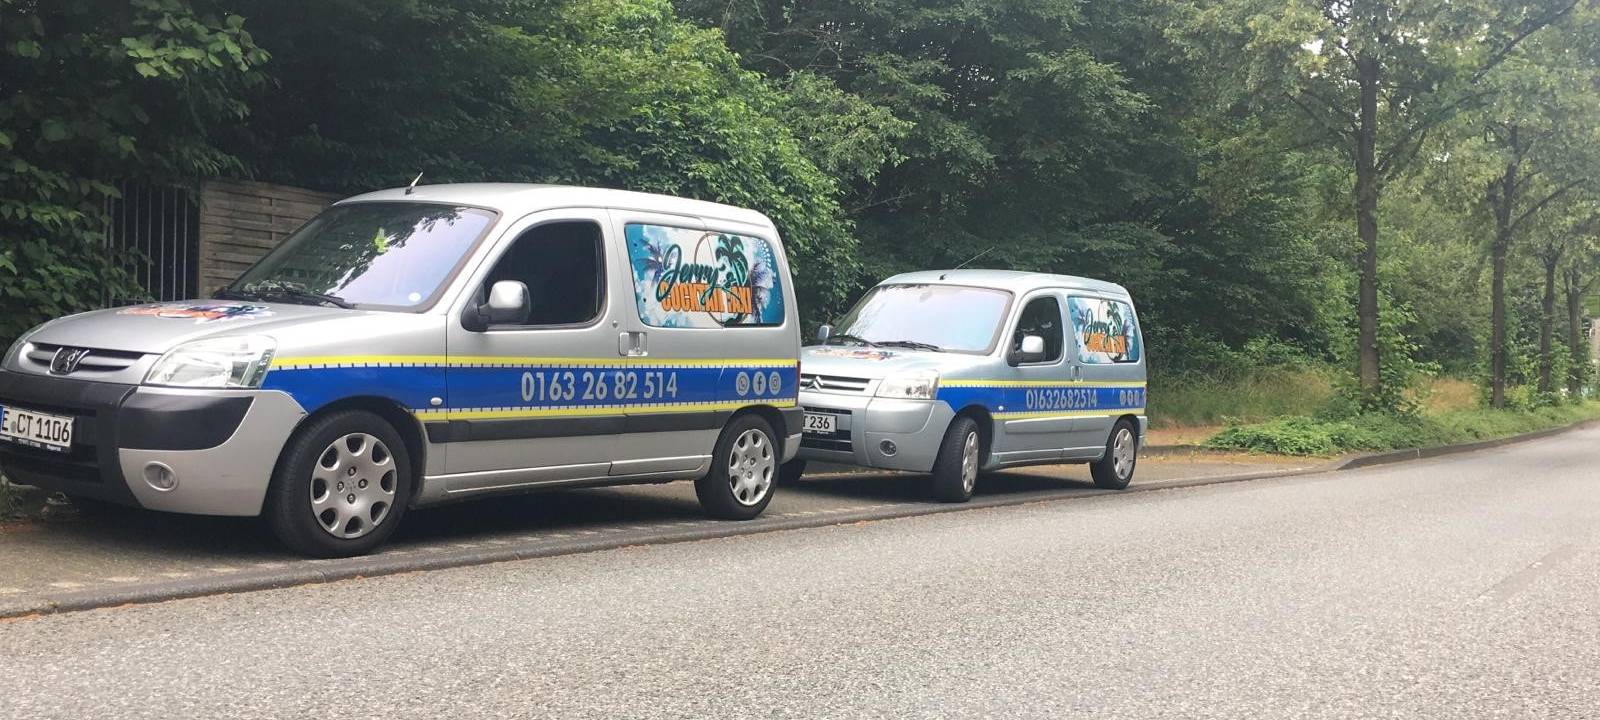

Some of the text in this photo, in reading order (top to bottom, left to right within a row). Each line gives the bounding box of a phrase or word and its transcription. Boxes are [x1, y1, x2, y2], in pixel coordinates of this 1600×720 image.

[656, 244, 737, 305] Jerry's
[660, 281, 753, 314] COCKTAIL TAXI
[521, 371, 678, 401] 0163 26 82 514
[1025, 389, 1097, 409] 01632682514
[2, 411, 9, 431] E
[17, 413, 33, 437] CT
[35, 417, 70, 443] 1106
[810, 416, 830, 429] 236
